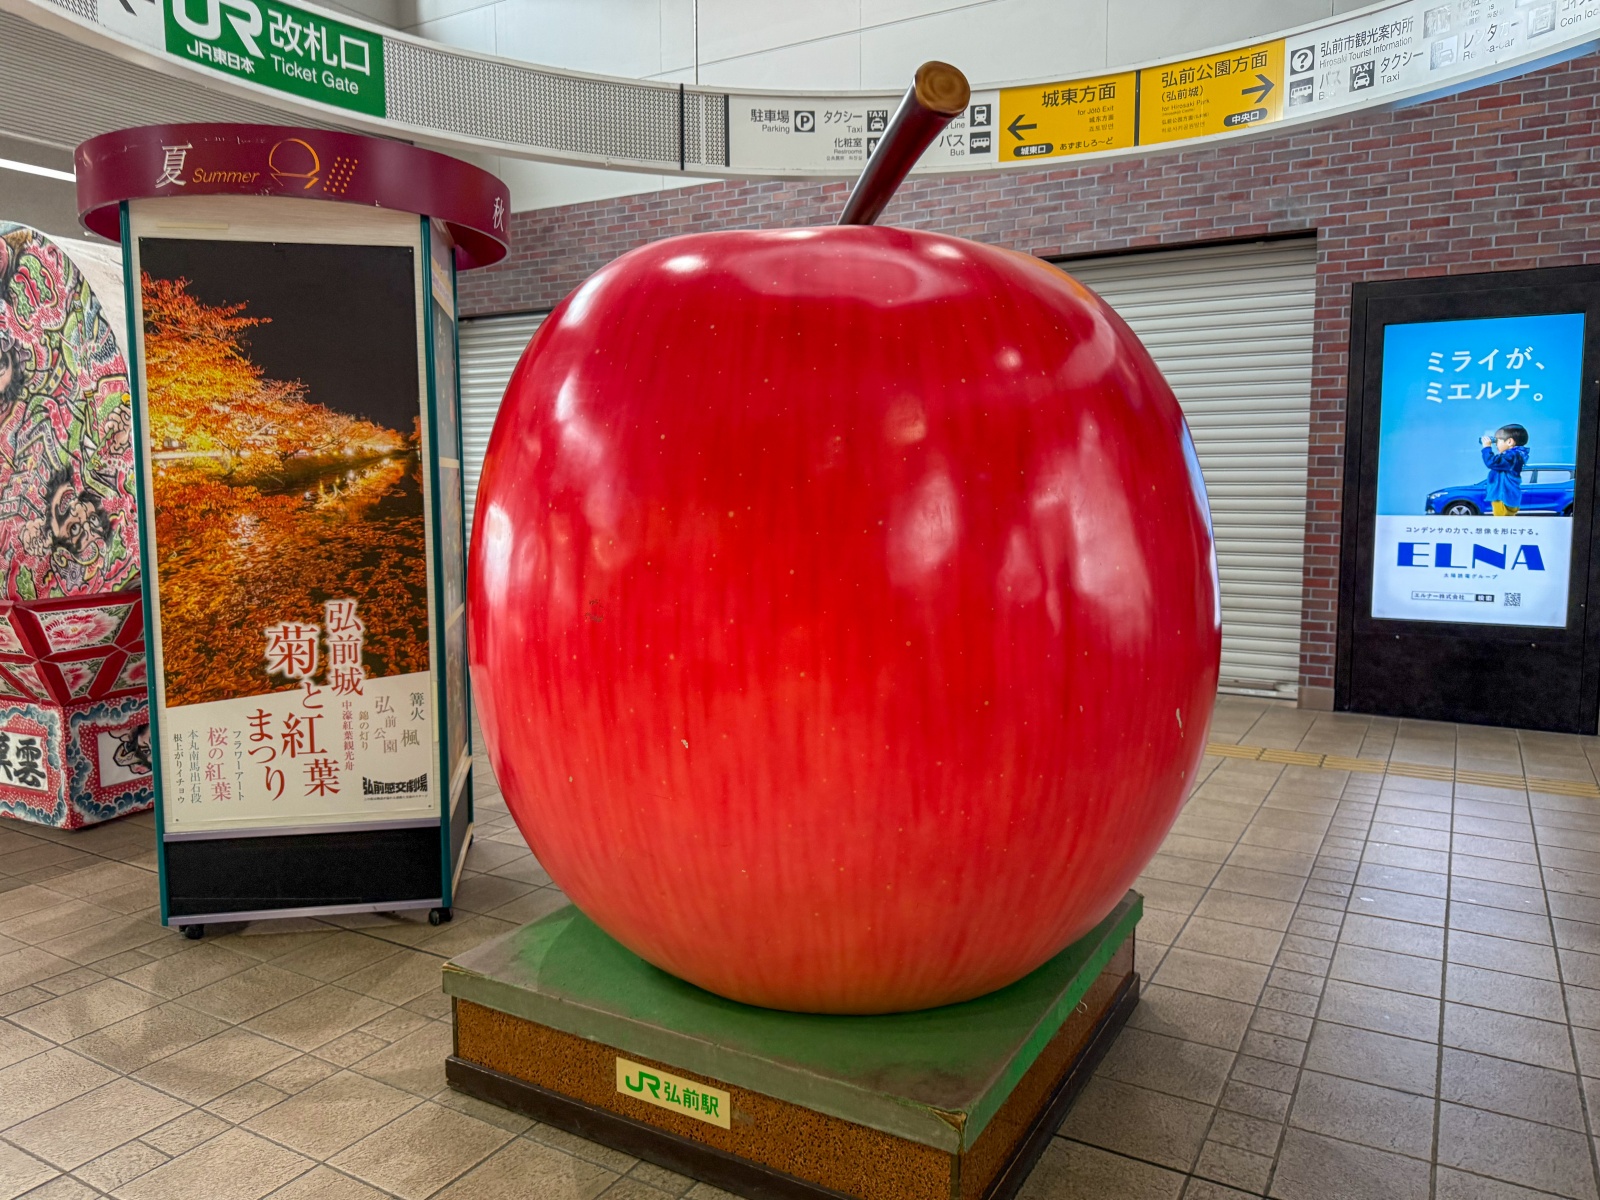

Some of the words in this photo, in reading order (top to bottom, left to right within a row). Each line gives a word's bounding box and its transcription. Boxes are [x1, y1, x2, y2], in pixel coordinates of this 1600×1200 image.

[1560, 13, 1582, 28] Coin
[267, 8, 371, 77] 改札口
[1320, 16, 1414, 58] 弘前市観光案内所
[1348, 48, 1372, 61] Tourist
[1373, 36, 1413, 54] Information
[186, 39, 256, 75] JR東日本
[1161, 50, 1268, 88] 弘前公園方面
[1351, 61, 1374, 75] TAXI
[1380, 51, 1424, 73] タクシー
[270, 53, 318, 84] Ticket
[322, 70, 360, 95] Gate
[1381, 71, 1400, 84] Taxi
[1042, 82, 1117, 108] 城東方面
[750, 109, 790, 123] 駐車場
[824, 110, 863, 124] タクシー
[1231, 112, 1260, 124] 中央口
[761, 125, 790, 134] Parking
[939, 134, 965, 147] バス
[834, 138, 862, 148] 化粧室
[155, 143, 194, 188] 夏
[192, 168, 260, 184] Summer
[492, 197, 505, 232] 秋
[1427, 346, 1545, 373] ミライが、
[1426, 378, 1544, 403] ミエルナ。
[1397, 542, 1546, 571] ELNA
[328, 602, 364, 697] 弘前城
[266, 624, 342, 797] 菊と紅葉
[401, 729, 420, 748] 楓
[204, 727, 232, 802] 桜の紅葉
[232, 730, 245, 801] フラワーアート
[246, 708, 287, 802] まつり
